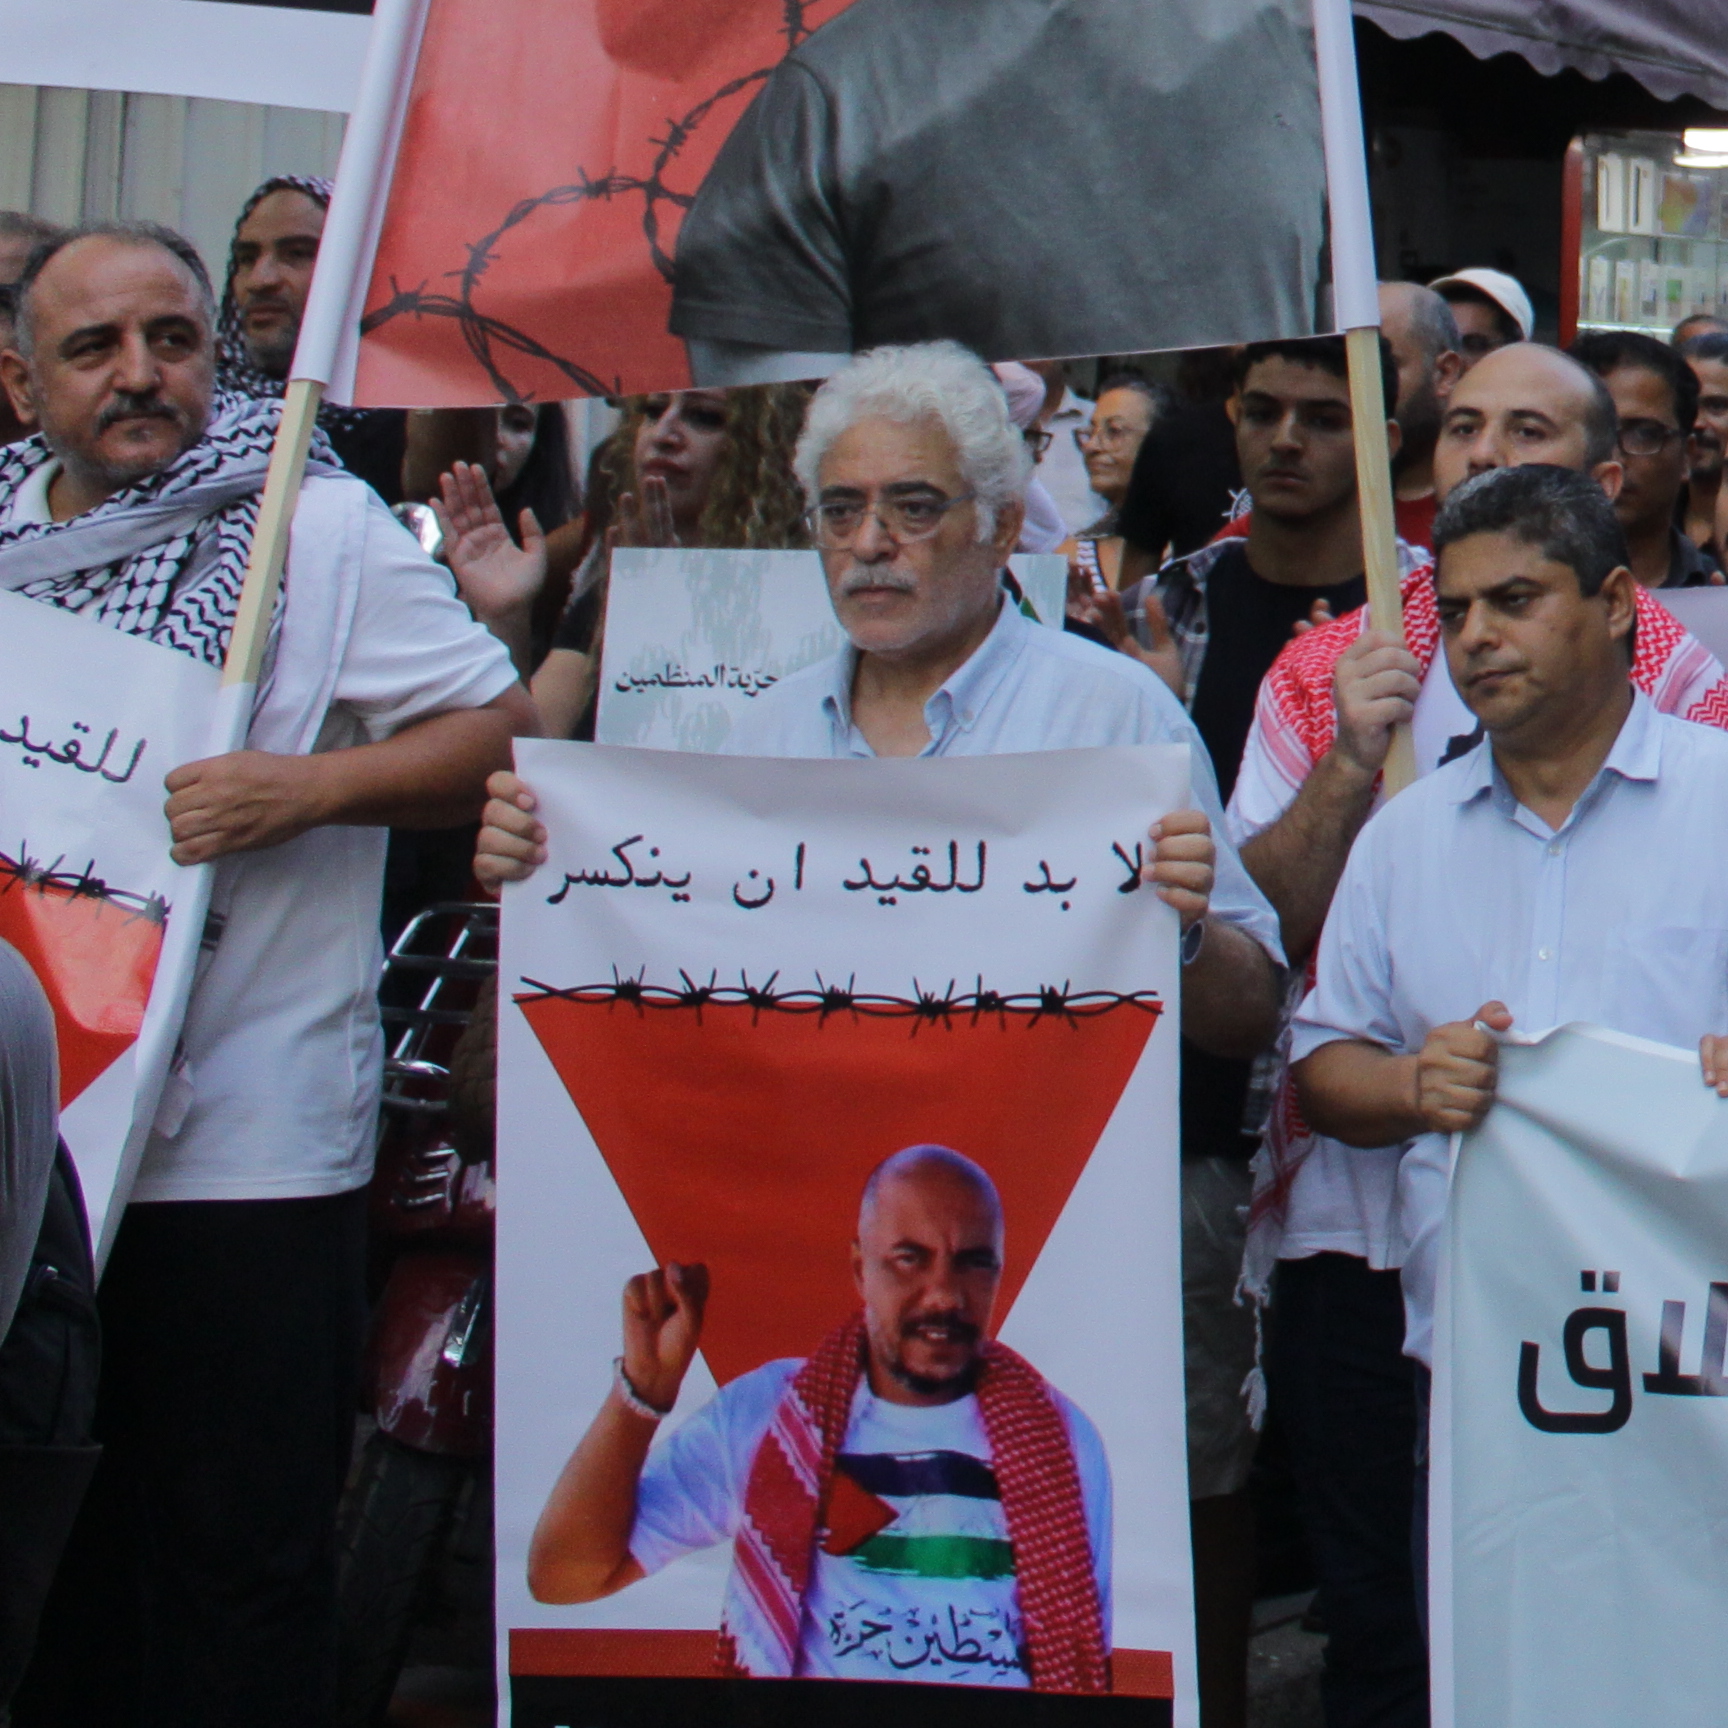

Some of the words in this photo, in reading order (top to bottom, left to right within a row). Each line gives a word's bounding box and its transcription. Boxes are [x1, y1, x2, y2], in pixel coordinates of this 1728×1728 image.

[614, 663, 727, 694] المنظمين
[545, 834, 693, 905] ينكسر
[841, 839, 987, 907] للقيد
[1022, 859, 1078, 912] بد
[1111, 840, 1144, 895] لا
